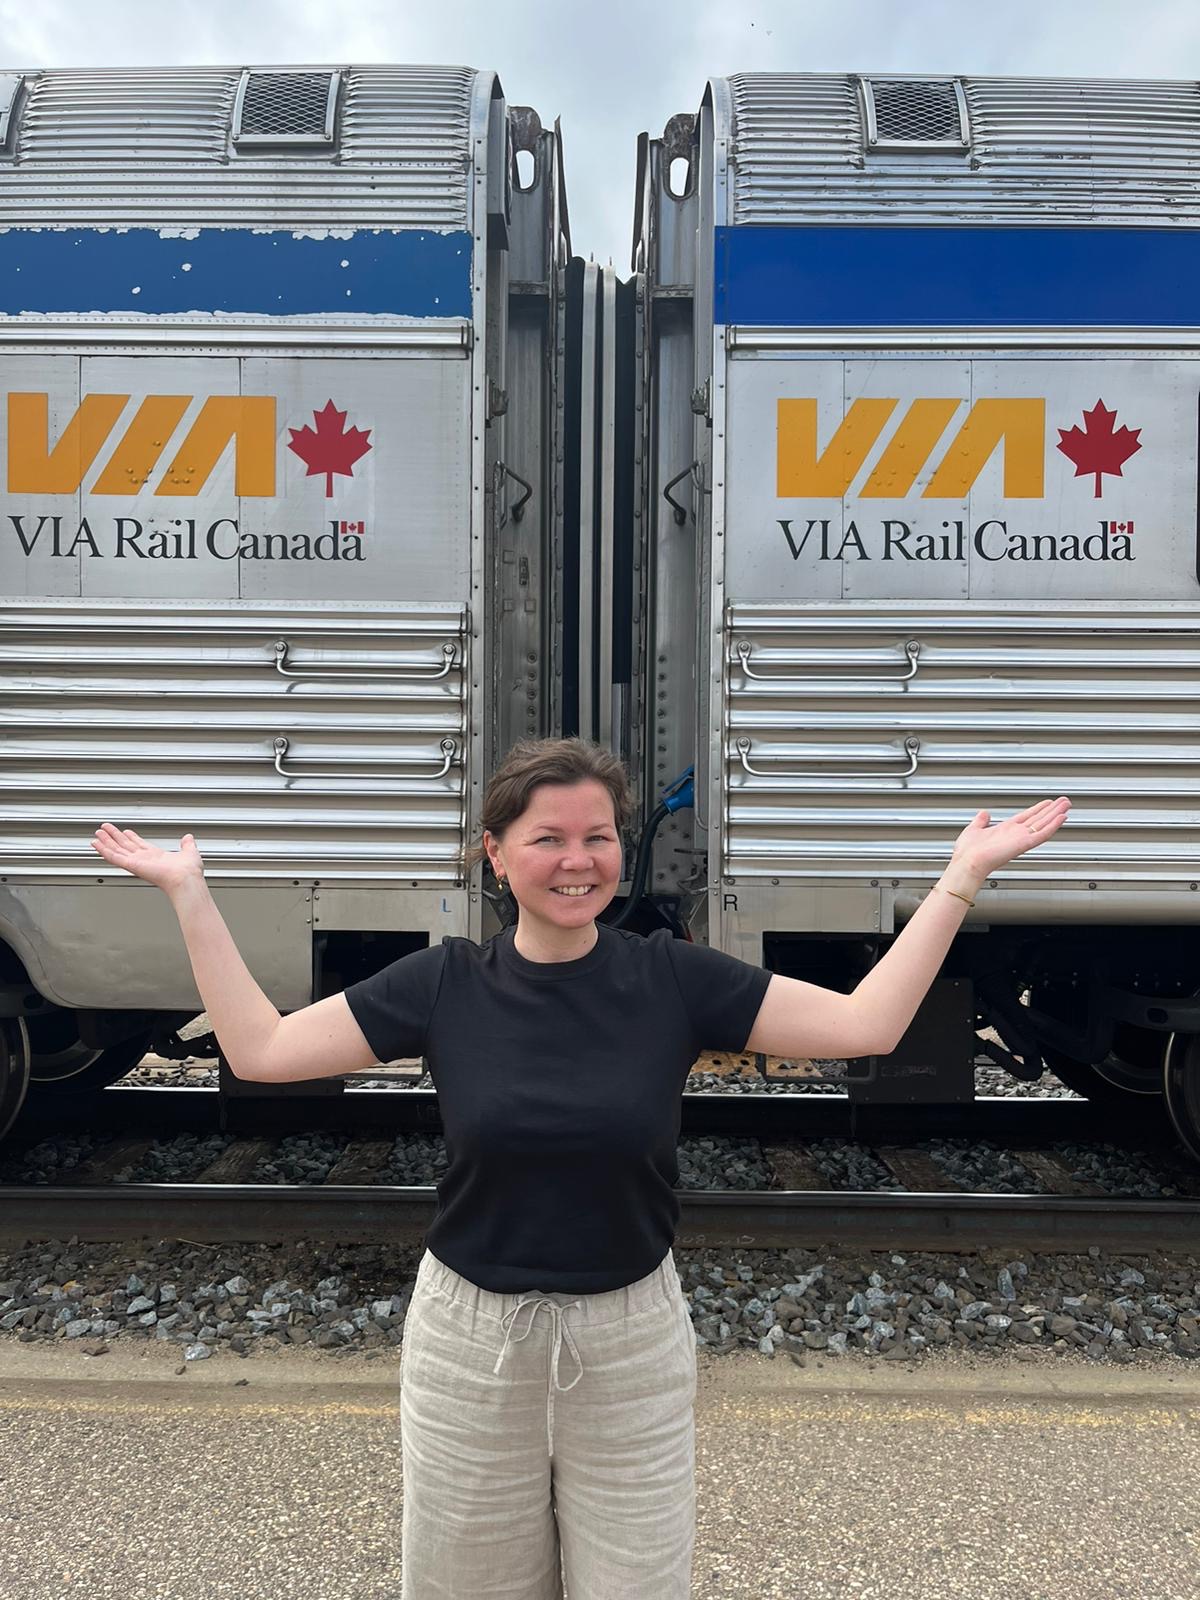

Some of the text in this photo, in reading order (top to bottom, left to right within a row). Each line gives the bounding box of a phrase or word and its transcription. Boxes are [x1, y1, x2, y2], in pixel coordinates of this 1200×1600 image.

[7, 392, 277, 497] VIA
[777, 398, 1046, 498] VIA
[7, 516, 366, 561] VIA Rail Canada
[776, 520, 1136, 561] VIA Rail Canada
[442, 898, 452, 912] L
[723, 894, 738, 911] R
